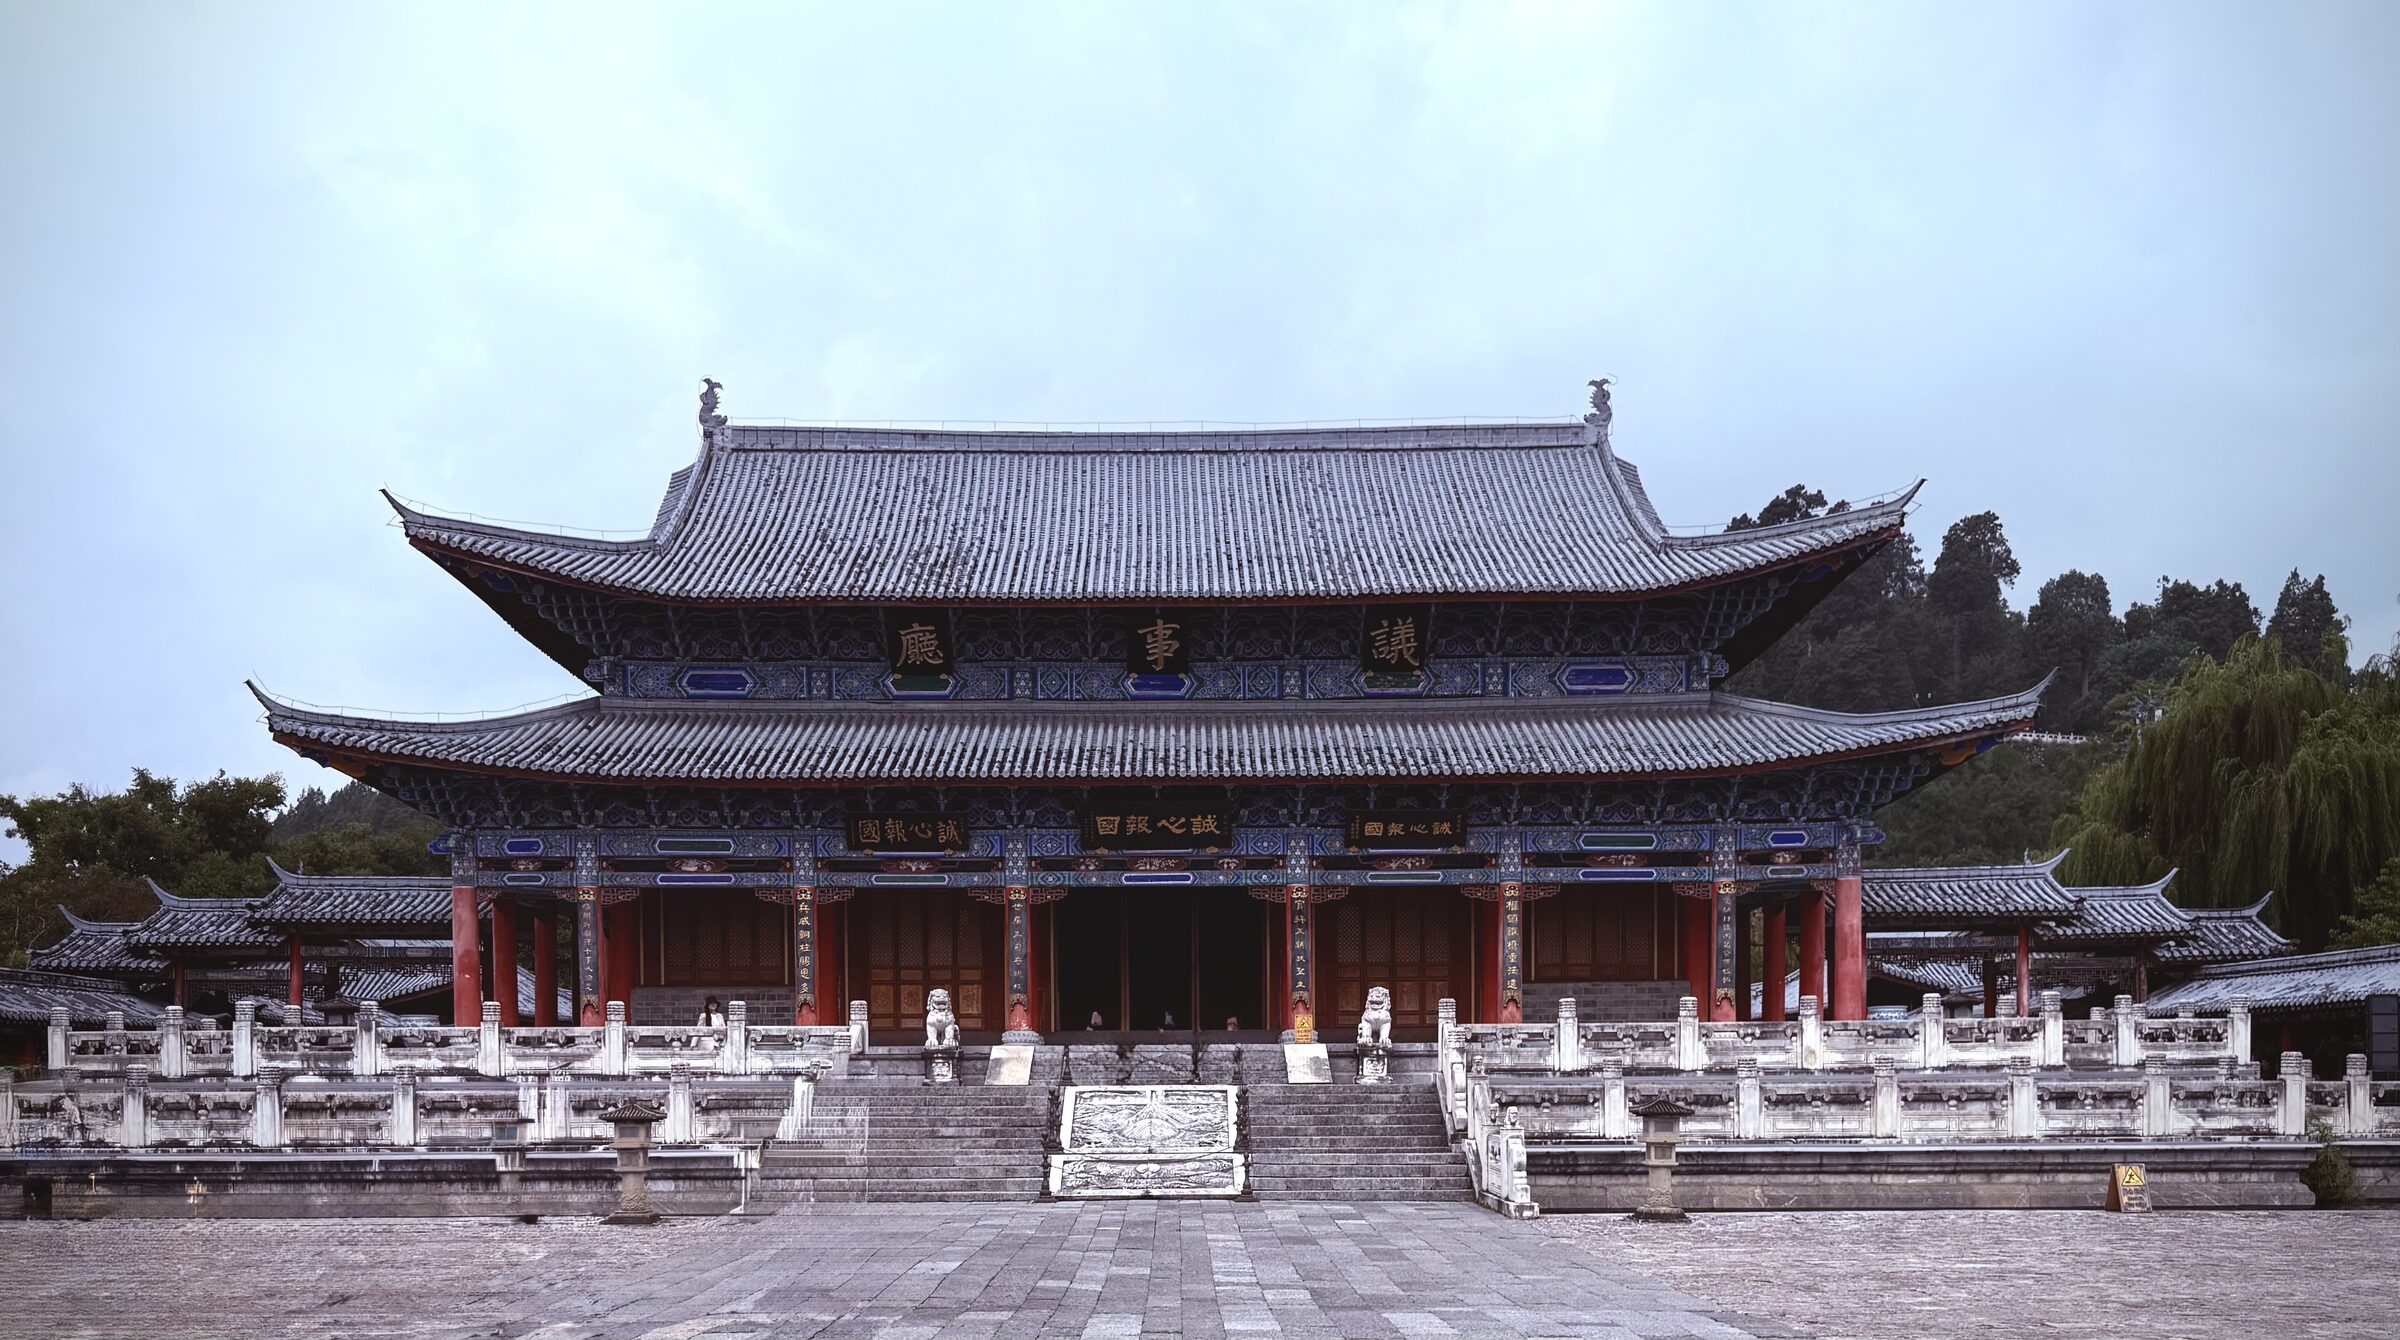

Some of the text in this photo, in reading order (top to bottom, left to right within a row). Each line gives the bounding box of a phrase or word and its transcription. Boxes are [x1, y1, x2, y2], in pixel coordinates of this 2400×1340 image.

[896, 623, 943, 667] 廳
[1137, 618, 1180, 671] 事
[1370, 617, 1419, 666] 議
